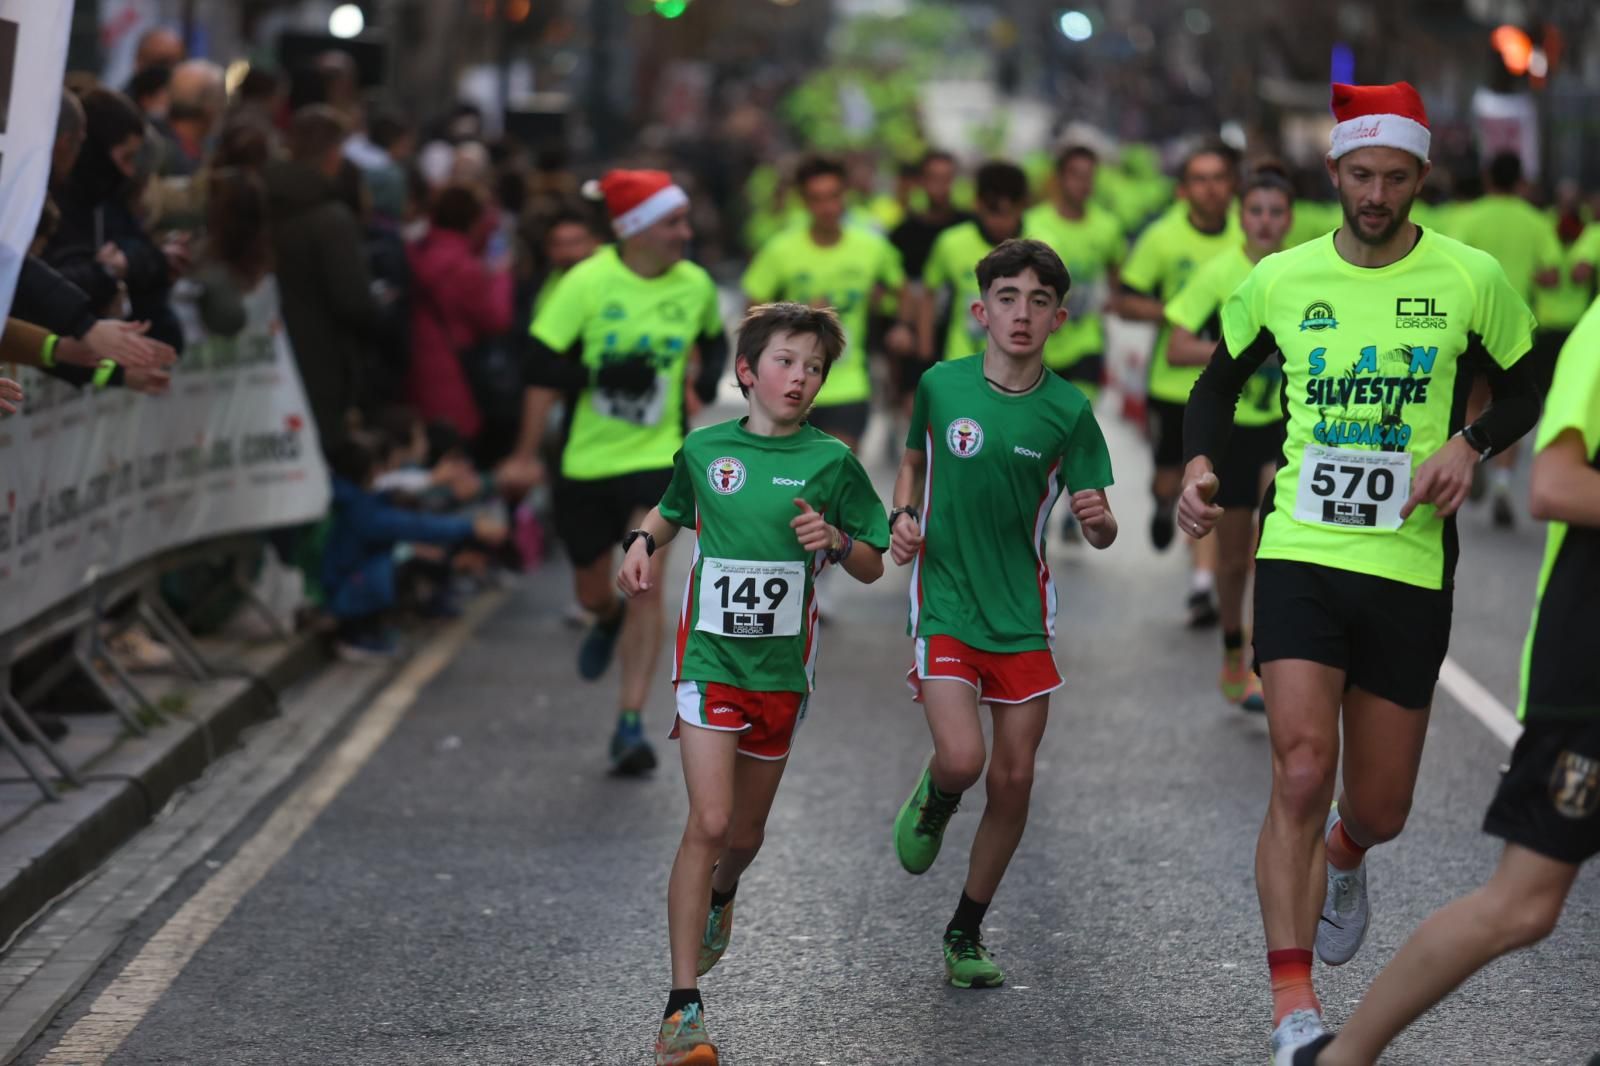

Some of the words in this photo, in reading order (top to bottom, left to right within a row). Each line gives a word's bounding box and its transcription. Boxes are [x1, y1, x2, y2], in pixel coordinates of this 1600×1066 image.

[1305, 377, 1431, 406] SILVESTRE
[1313, 421, 1411, 447] GALDAKAO
[1310, 462, 1394, 501] 570
[713, 575, 789, 610] 149
